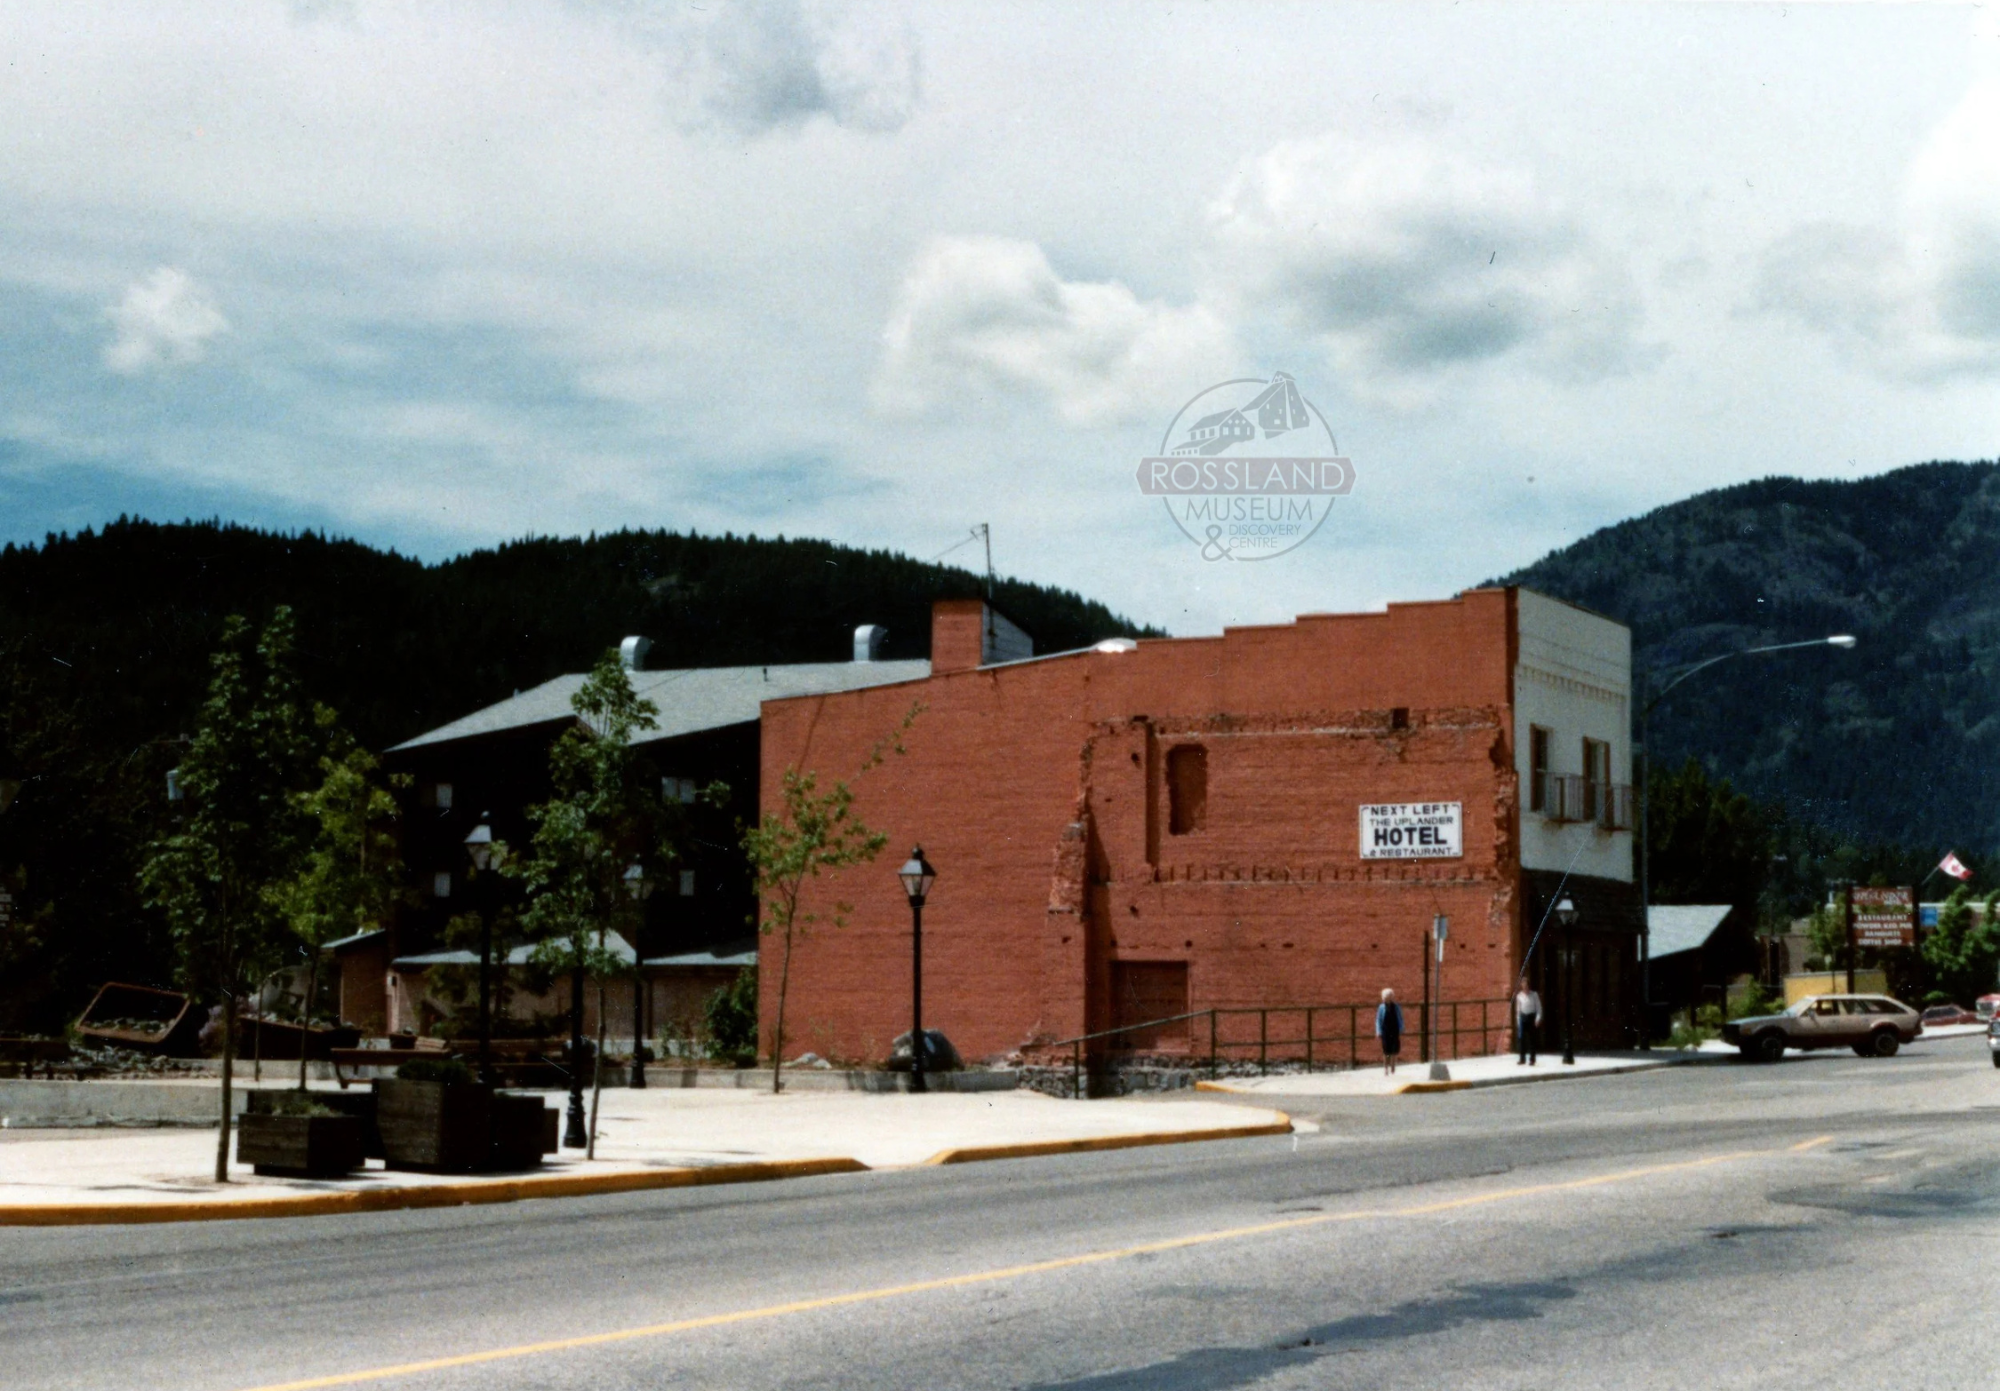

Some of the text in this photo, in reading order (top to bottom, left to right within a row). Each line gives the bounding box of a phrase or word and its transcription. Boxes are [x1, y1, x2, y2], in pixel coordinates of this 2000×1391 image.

[1371, 804, 1449, 816] NEXT LEFT
[1369, 816, 1454, 826] THE UPLANDER
[1374, 826, 1447, 846] HOTEL
[1380, 847, 1453, 857] RESTAURANT
